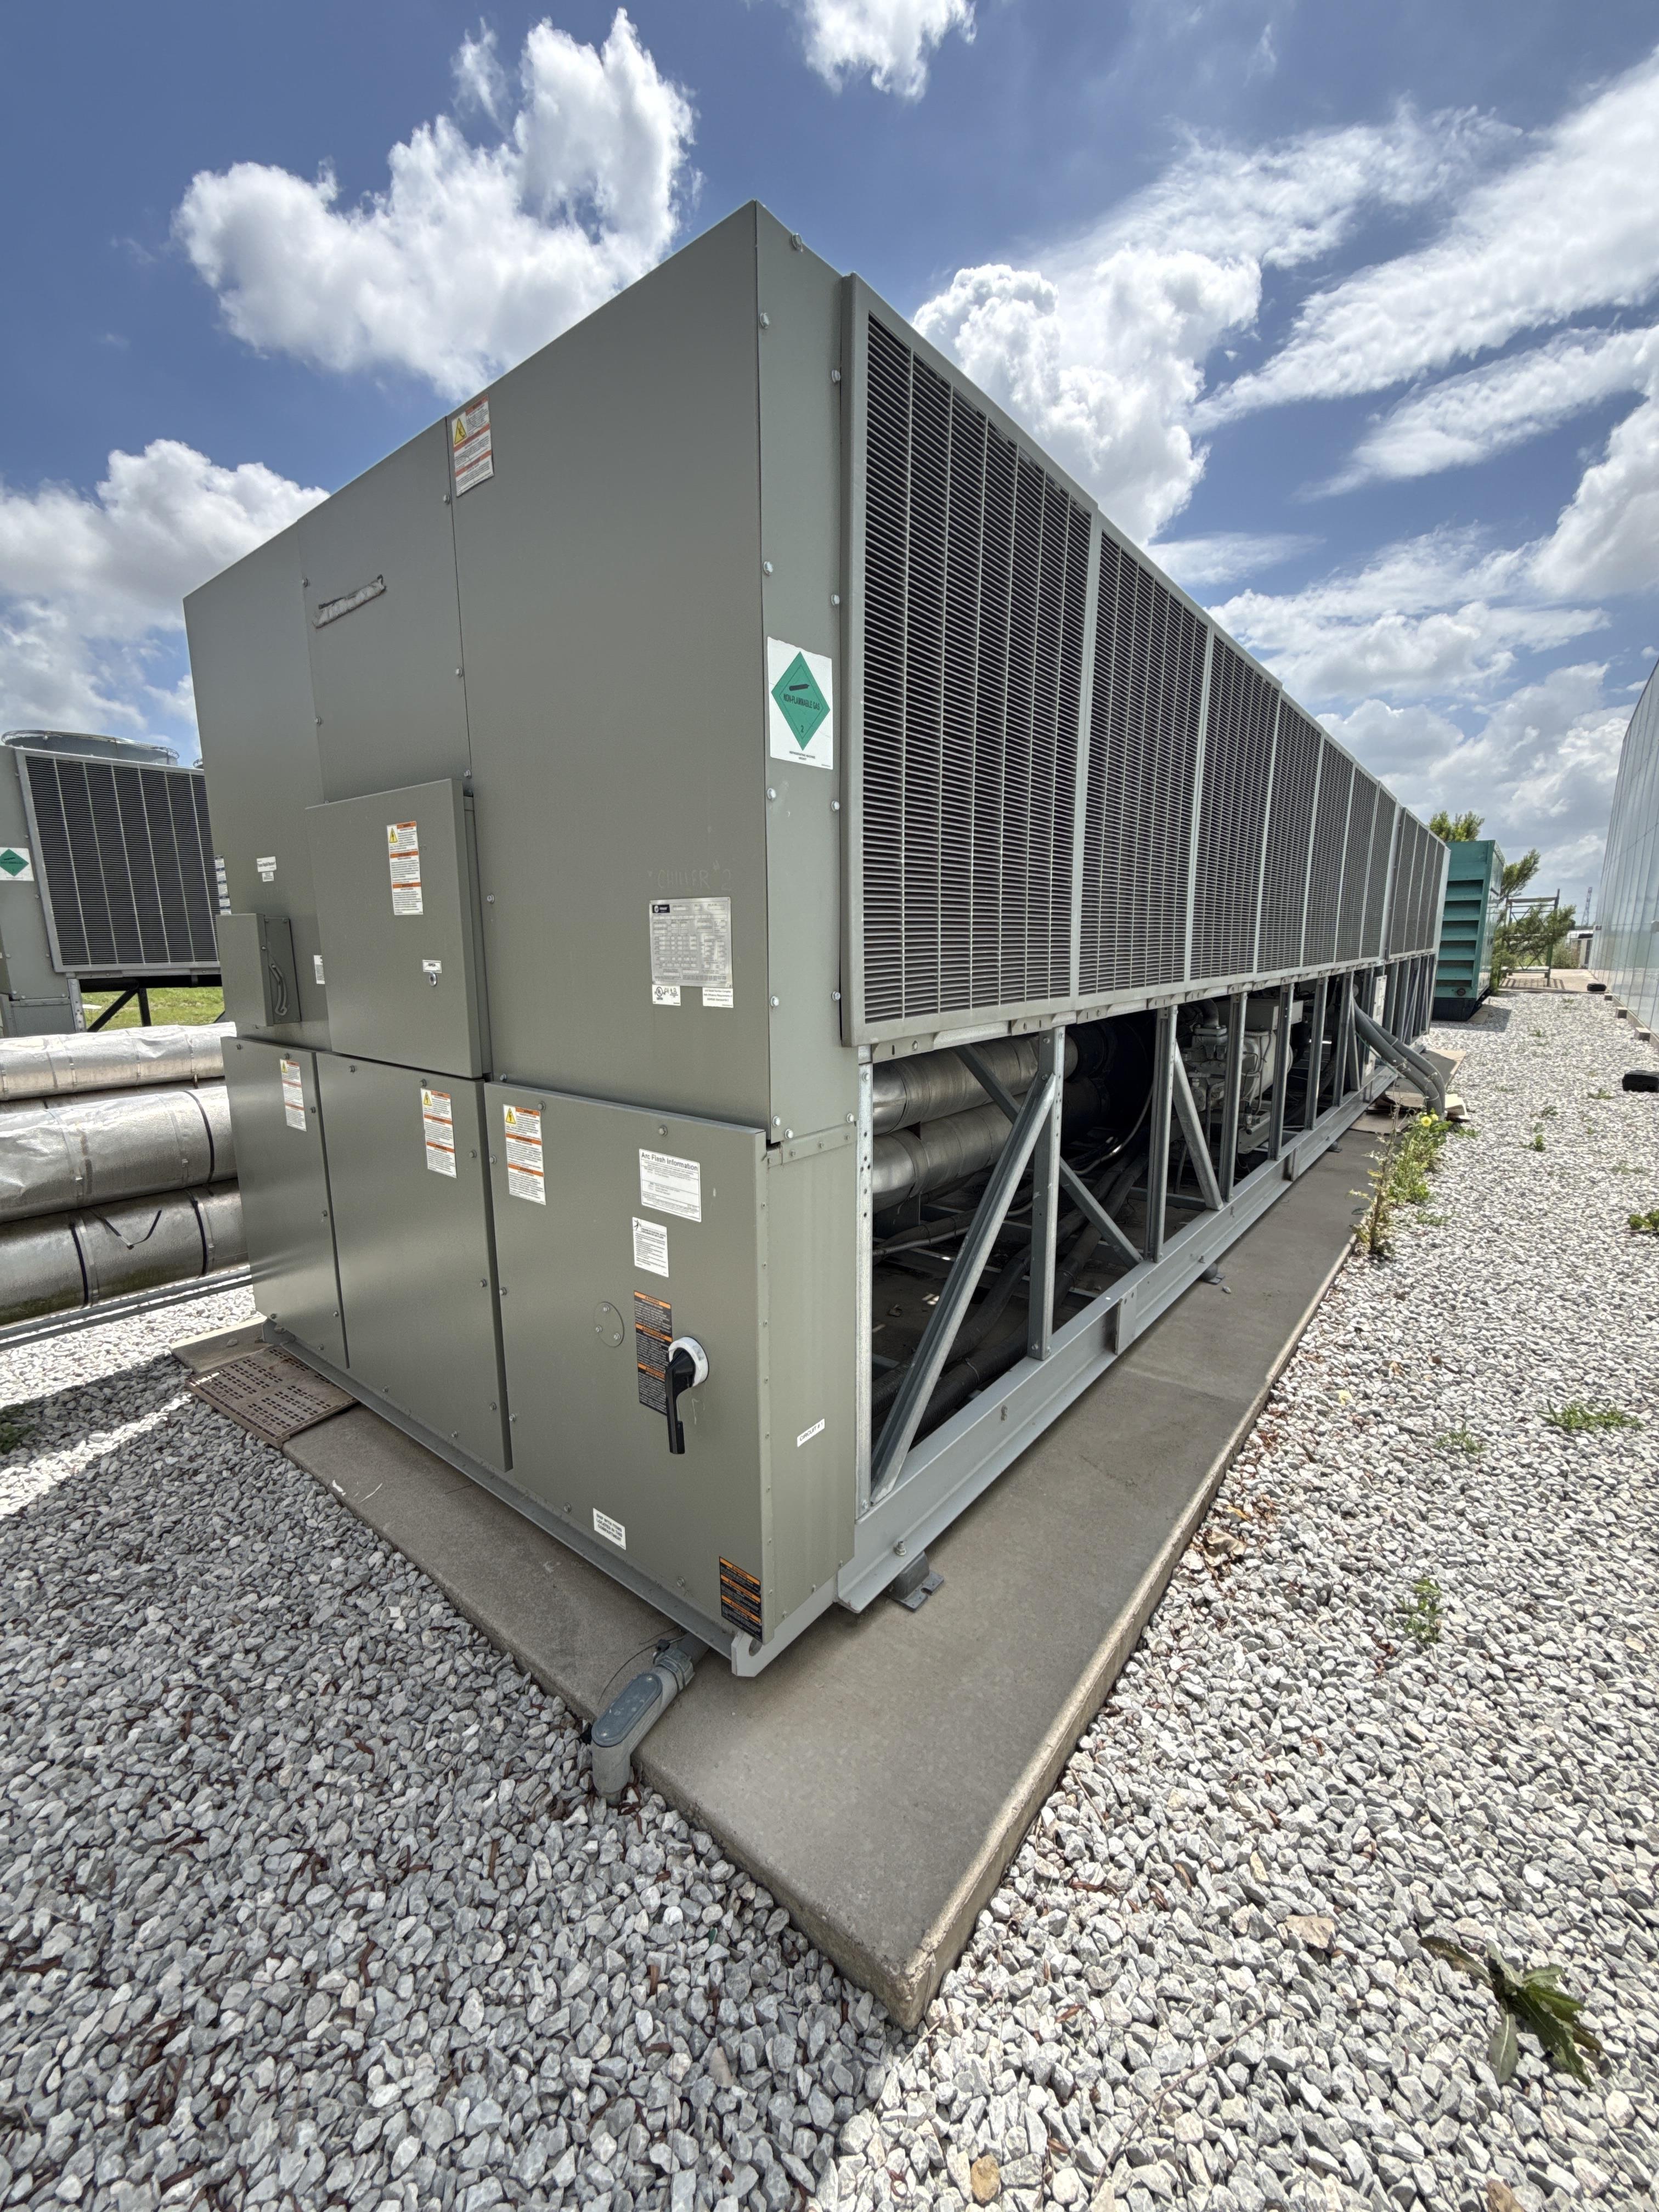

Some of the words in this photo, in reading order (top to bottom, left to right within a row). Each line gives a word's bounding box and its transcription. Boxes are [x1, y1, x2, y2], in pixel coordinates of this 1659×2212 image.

[783, 693, 812, 708] NON-FLAMMABLE
[801, 725, 804, 733] 2
[651, 1154, 665, 1163] Flash
[667, 1158, 698, 1171] Information
